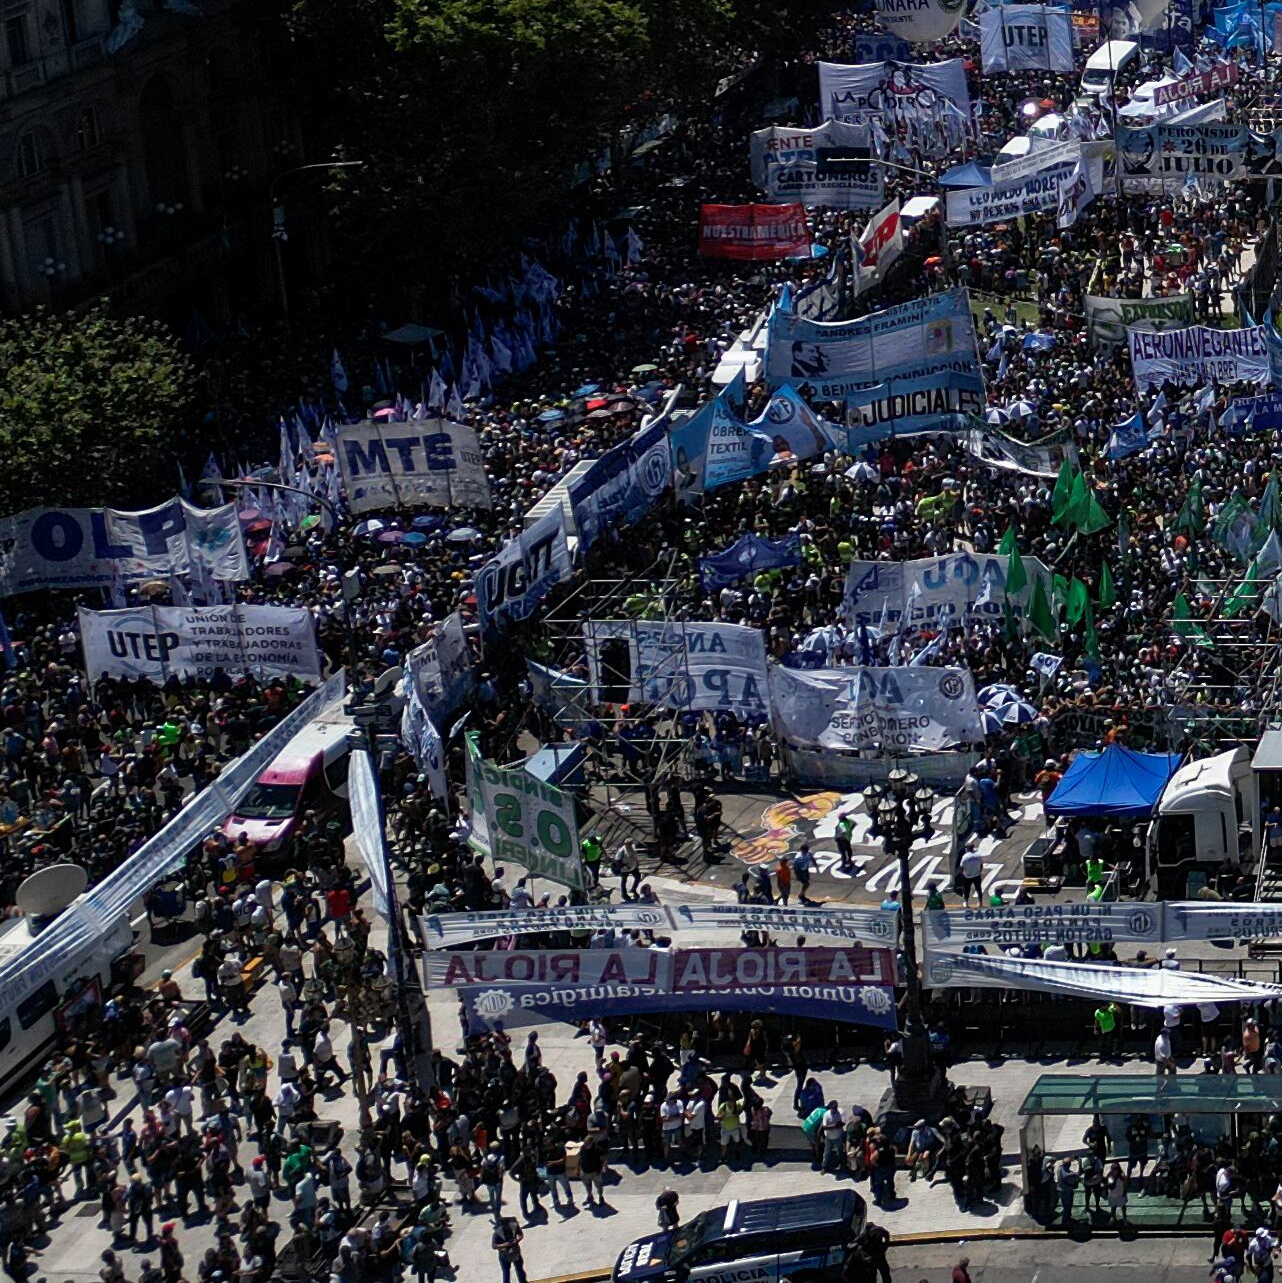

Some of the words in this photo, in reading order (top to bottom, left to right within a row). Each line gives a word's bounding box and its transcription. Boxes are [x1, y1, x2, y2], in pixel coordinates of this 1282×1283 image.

[1002, 26, 1048, 47] UTEP
[835, 91, 855, 103] LA
[1181, 139, 1207, 154] 26
[1160, 156, 1232, 174] JULIO
[1133, 326, 1268, 360] AERONAVEGANTES
[862, 388, 982, 427] JUDICIALES
[344, 433, 456, 475] MTE
[711, 443, 747, 455] TEXTIL
[31, 504, 186, 561] OLP
[232, 614, 246, 623] DE
[192, 627, 289, 636] TRABAJADORES
[107, 630, 179, 662] UTEP
[206, 640, 301, 650] TRABAJADORAS
[196, 653, 211, 662] DE
[216, 654, 231, 662] LA
[234, 652, 298, 662] ECONOMÍA
